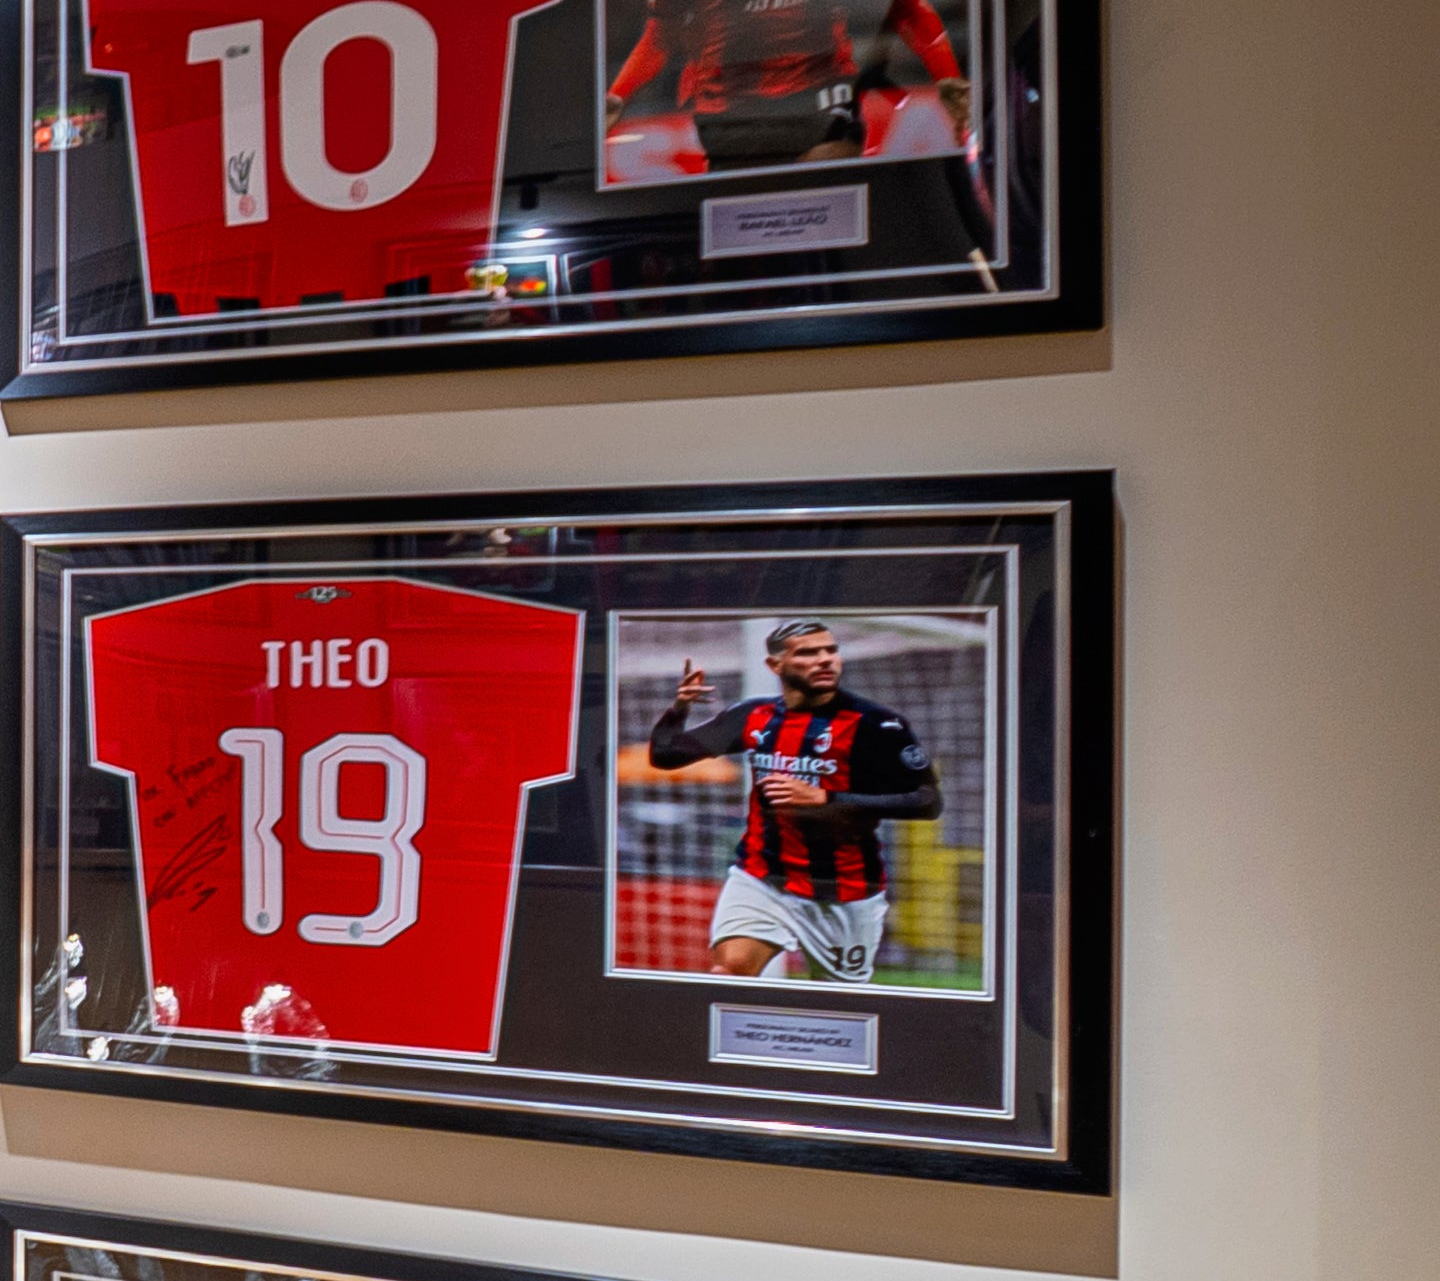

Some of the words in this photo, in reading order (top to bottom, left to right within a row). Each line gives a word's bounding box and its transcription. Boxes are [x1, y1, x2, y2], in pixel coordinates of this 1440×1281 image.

[186, 0, 439, 228] 10
[261, 638, 390, 688] THEO
[218, 727, 427, 947] 19
